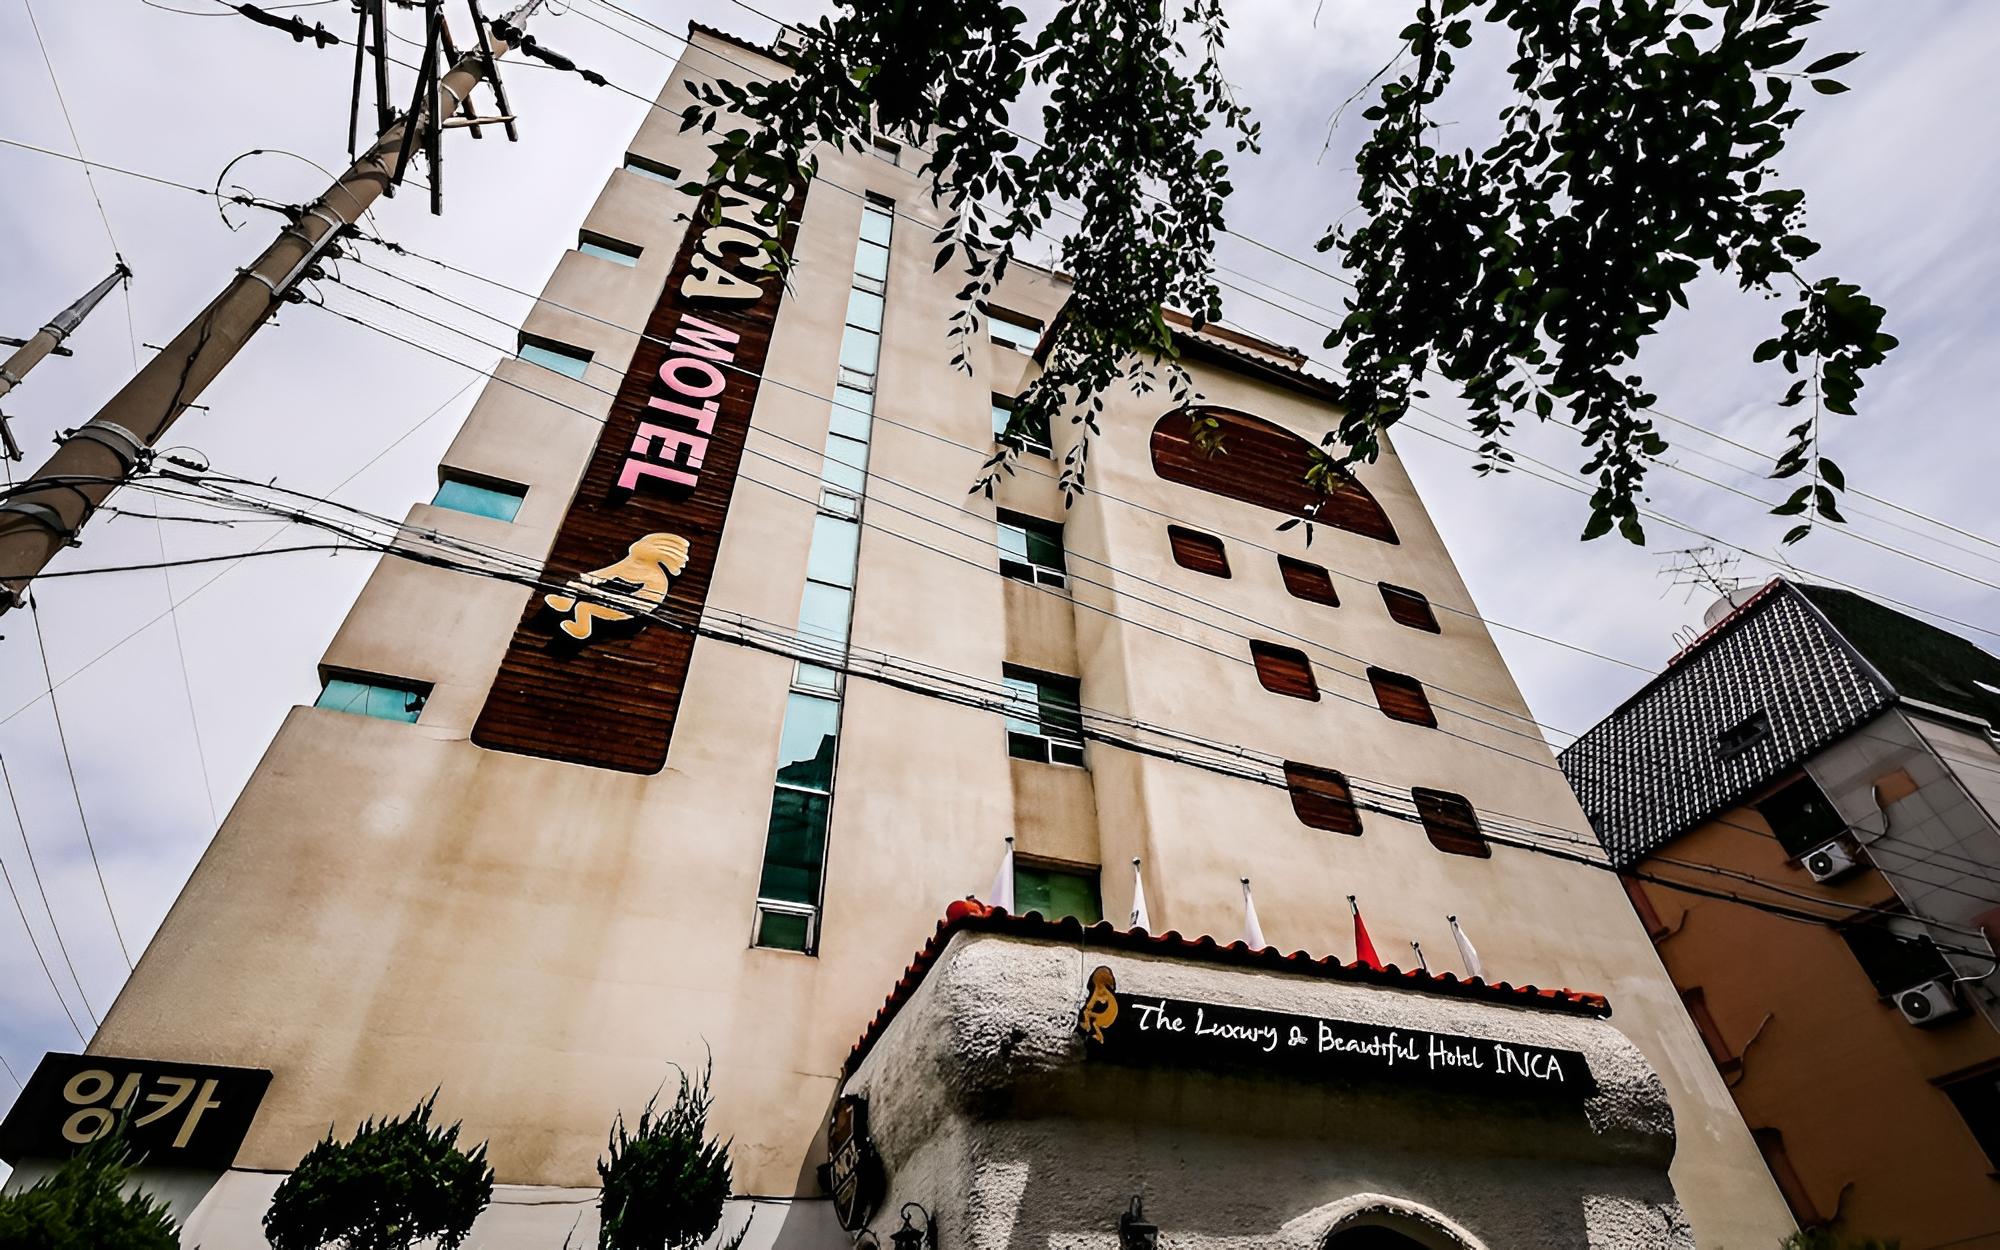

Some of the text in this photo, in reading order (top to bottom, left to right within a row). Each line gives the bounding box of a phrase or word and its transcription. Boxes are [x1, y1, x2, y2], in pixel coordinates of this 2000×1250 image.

[617, 313, 740, 490] MOTEL
[1131, 1000, 1186, 1032] The
[1195, 1007, 1278, 1052] Luxury
[1318, 1020, 1420, 1066] Beautiful
[1428, 1034, 1484, 1070] Hotel
[1493, 1044, 1565, 1082] INCA
[61, 1069, 221, 1148] 잉카
